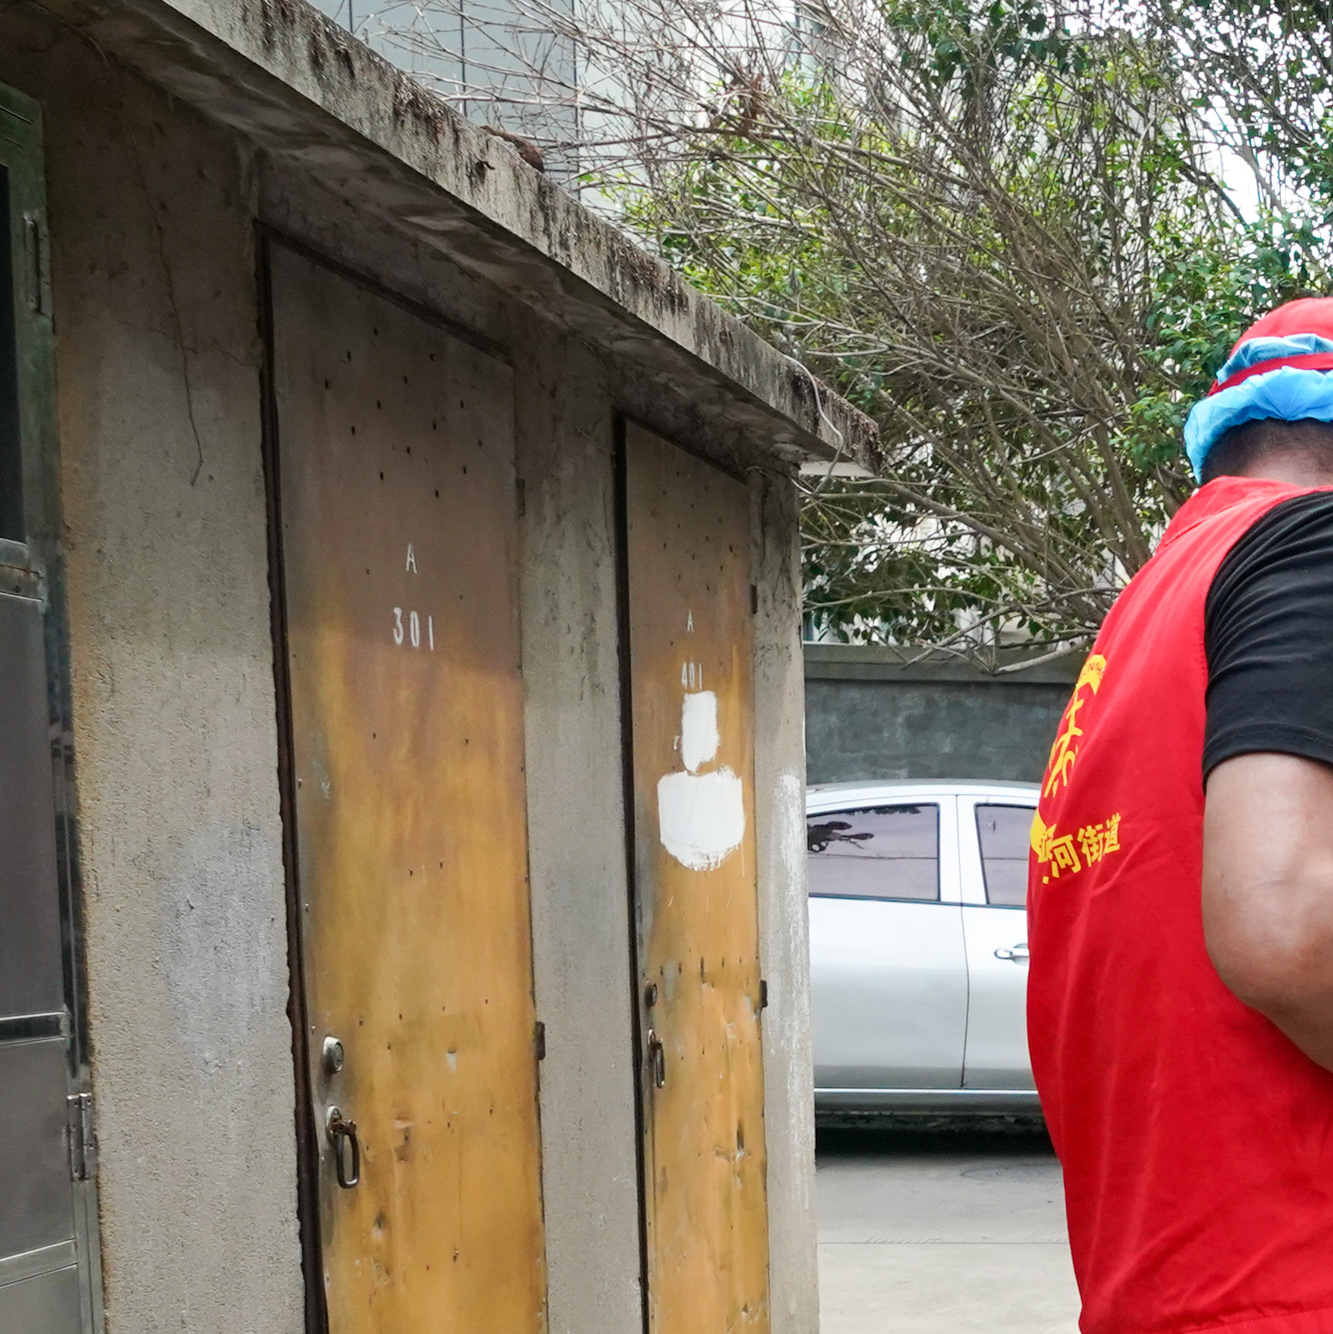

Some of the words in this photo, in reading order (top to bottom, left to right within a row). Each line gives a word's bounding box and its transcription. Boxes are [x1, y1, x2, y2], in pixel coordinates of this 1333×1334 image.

[404, 542, 418, 575] A
[392, 607, 435, 651] 301
[686, 608, 695, 633] A
[680, 662, 704, 690] 401
